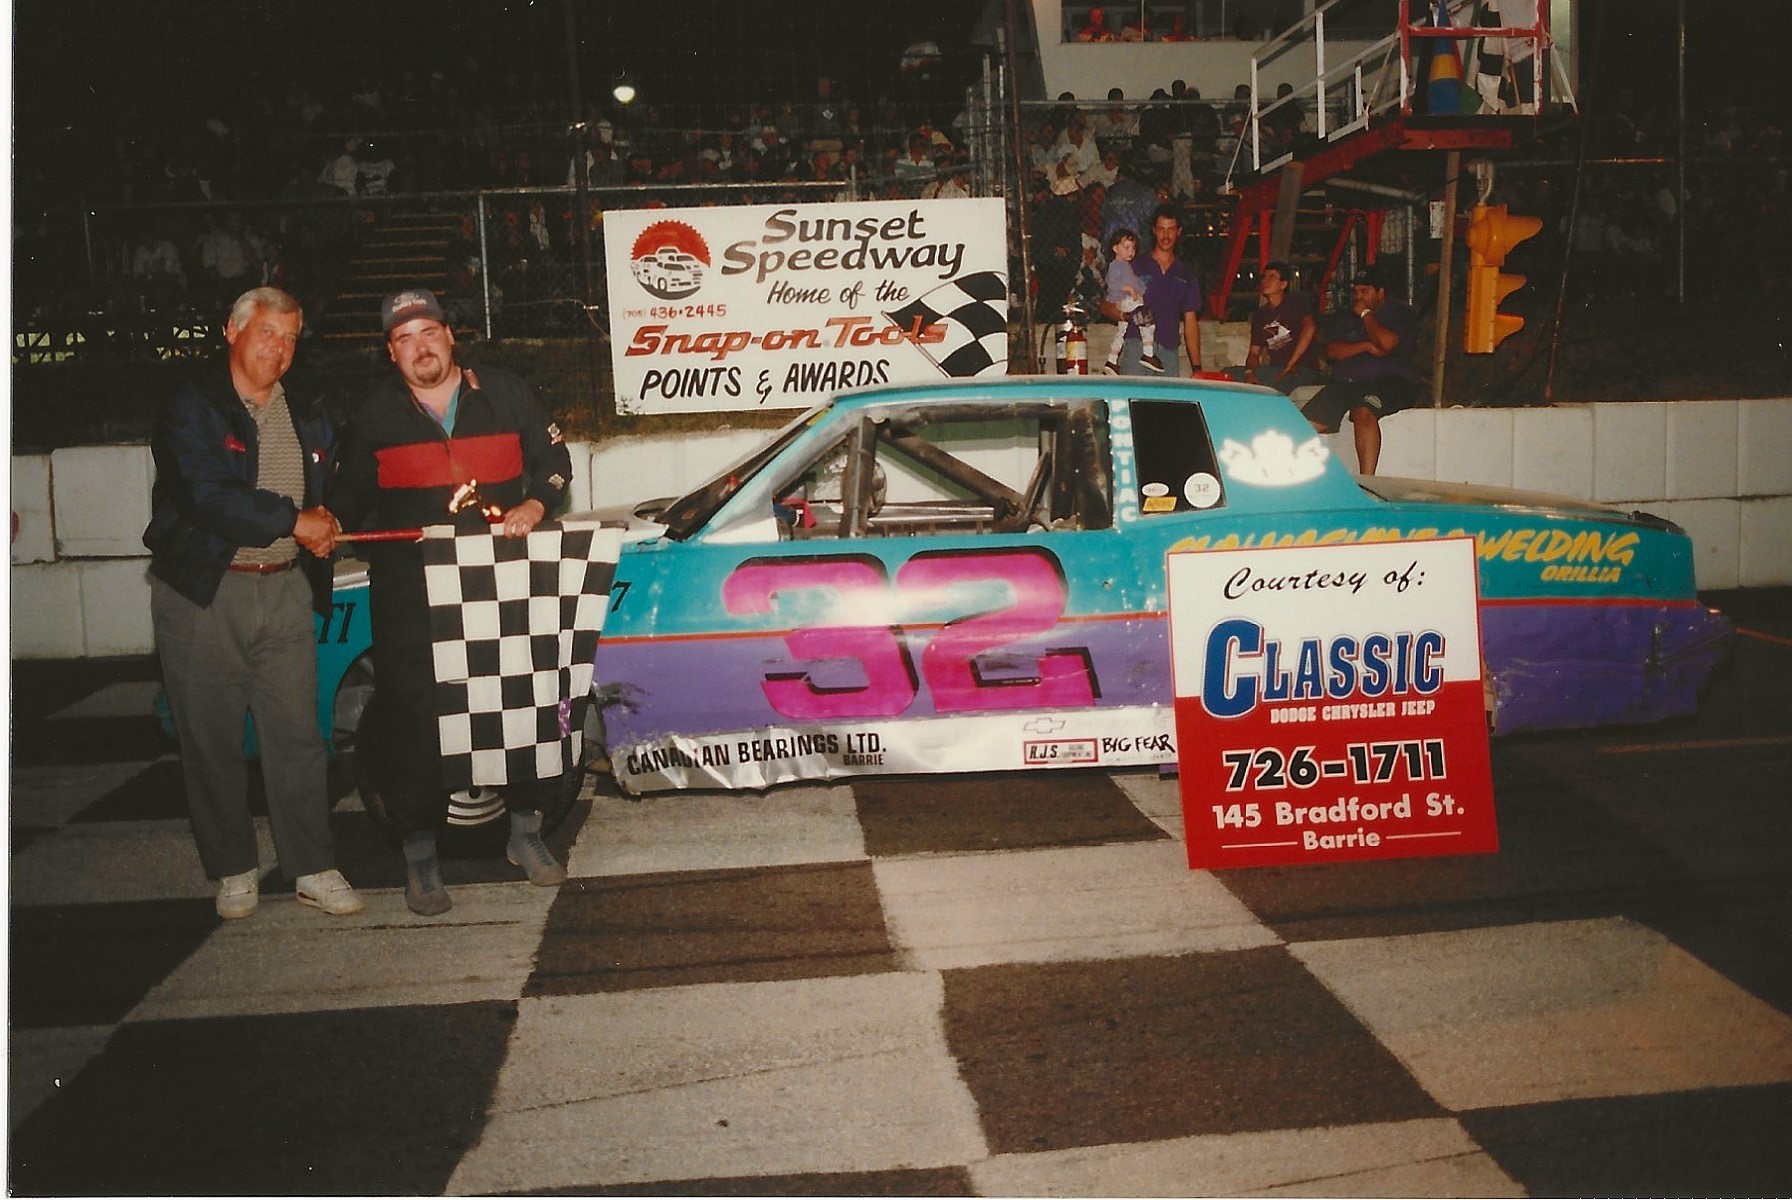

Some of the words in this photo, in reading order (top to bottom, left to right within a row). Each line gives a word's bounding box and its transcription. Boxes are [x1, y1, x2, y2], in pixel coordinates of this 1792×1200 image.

[763, 209, 926, 244] Sunset
[721, 240, 965, 283] Speedway
[767, 280, 831, 304] Home
[840, 280, 868, 309] of
[875, 279, 909, 302] the
[625, 324, 822, 361] Snap-on
[826, 315, 949, 349] Tools
[640, 366, 742, 400] POINTS
[757, 369, 772, 403] &
[782, 359, 890, 394] AWARDS
[1476, 529, 1640, 566] WELDING
[1223, 566, 1368, 600] Courtesy
[1383, 561, 1425, 593] of:
[1540, 565, 1622, 583] ORILLIA
[722, 545, 1102, 719] 32
[1202, 617, 1446, 718] CLASSIC
[1270, 706, 1317, 724] DODGE
[1321, 702, 1396, 721] CHRYSLER
[1401, 700, 1436, 716] JEEP
[738, 733, 839, 764] BEARINGS
[847, 732, 887, 754] LTD.
[843, 753, 884, 766] BARRIE
[1102, 737, 1131, 753] BIG
[1135, 734, 1175, 753] FEAR
[1222, 738, 1447, 792] 726-1711
[1212, 803, 1262, 829] 145
[1276, 793, 1411, 826] Bradford
[1426, 792, 1465, 817] St.
[1303, 828, 1381, 850] Barrie
